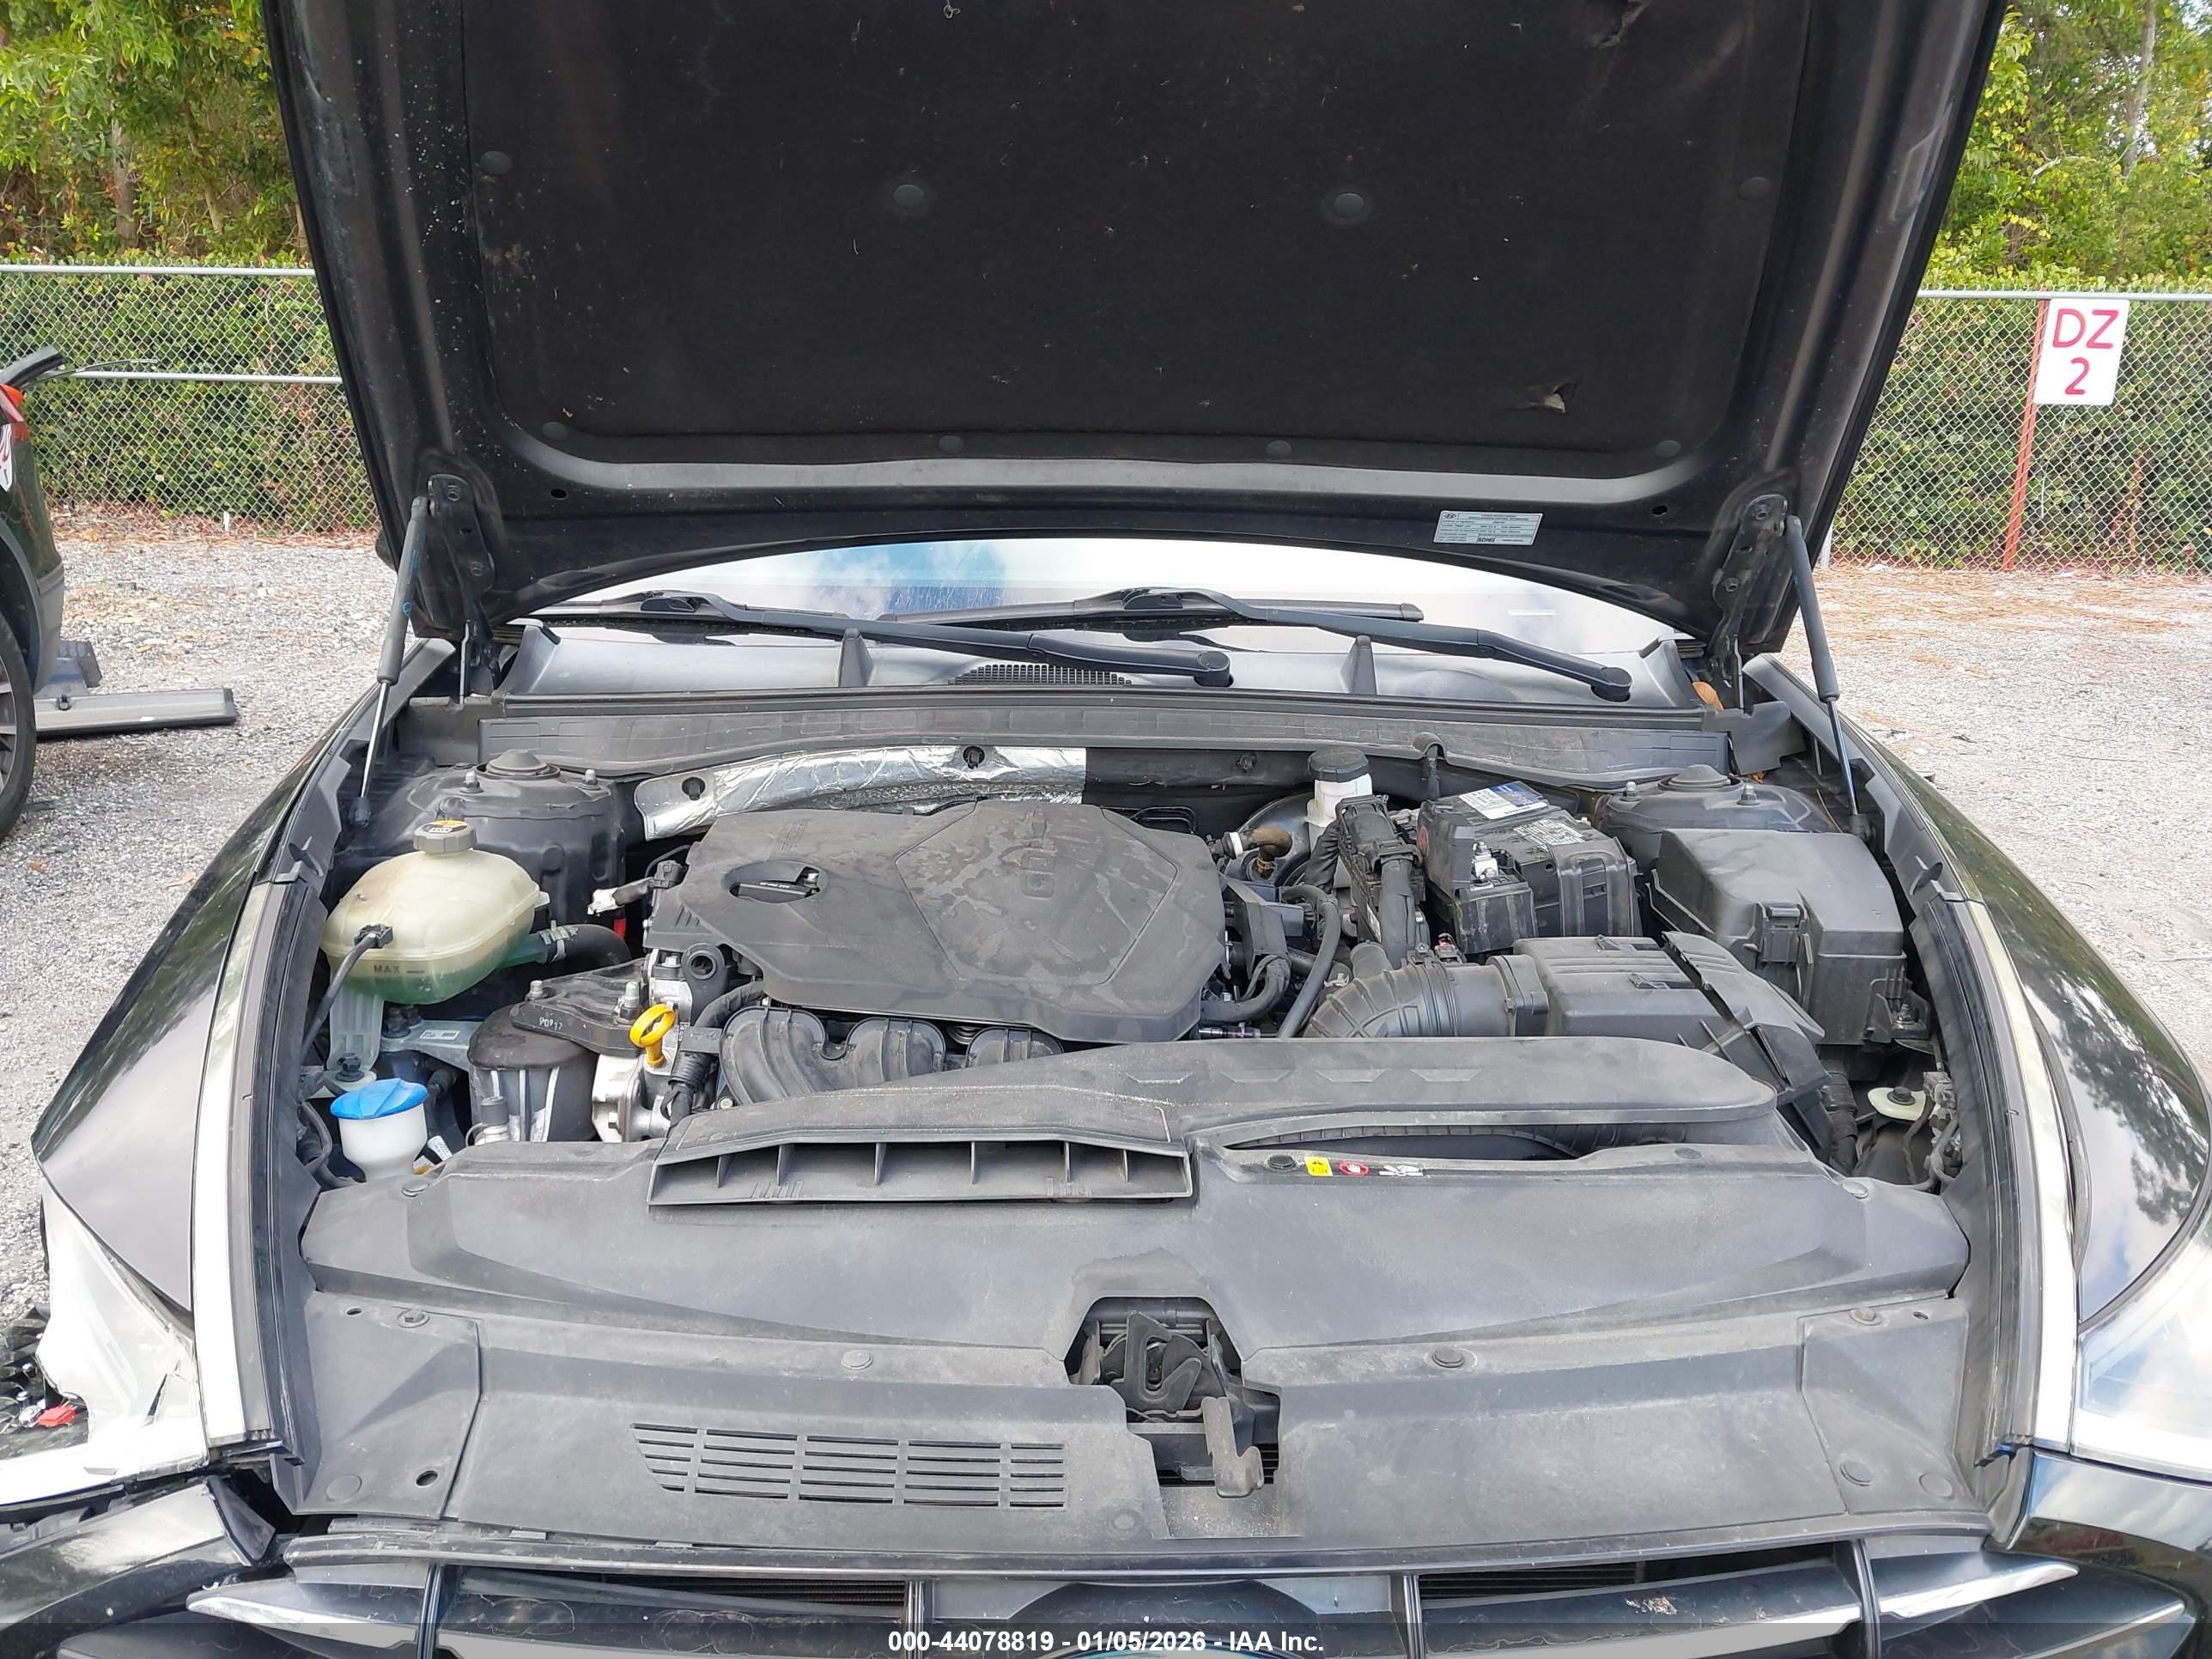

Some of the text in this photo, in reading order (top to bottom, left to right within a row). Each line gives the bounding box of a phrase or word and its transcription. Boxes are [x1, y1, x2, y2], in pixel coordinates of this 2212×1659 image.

[2052, 308, 2119, 349] DZ
[2065, 356, 2090, 395] 2
[374, 964, 400, 974] MAX
